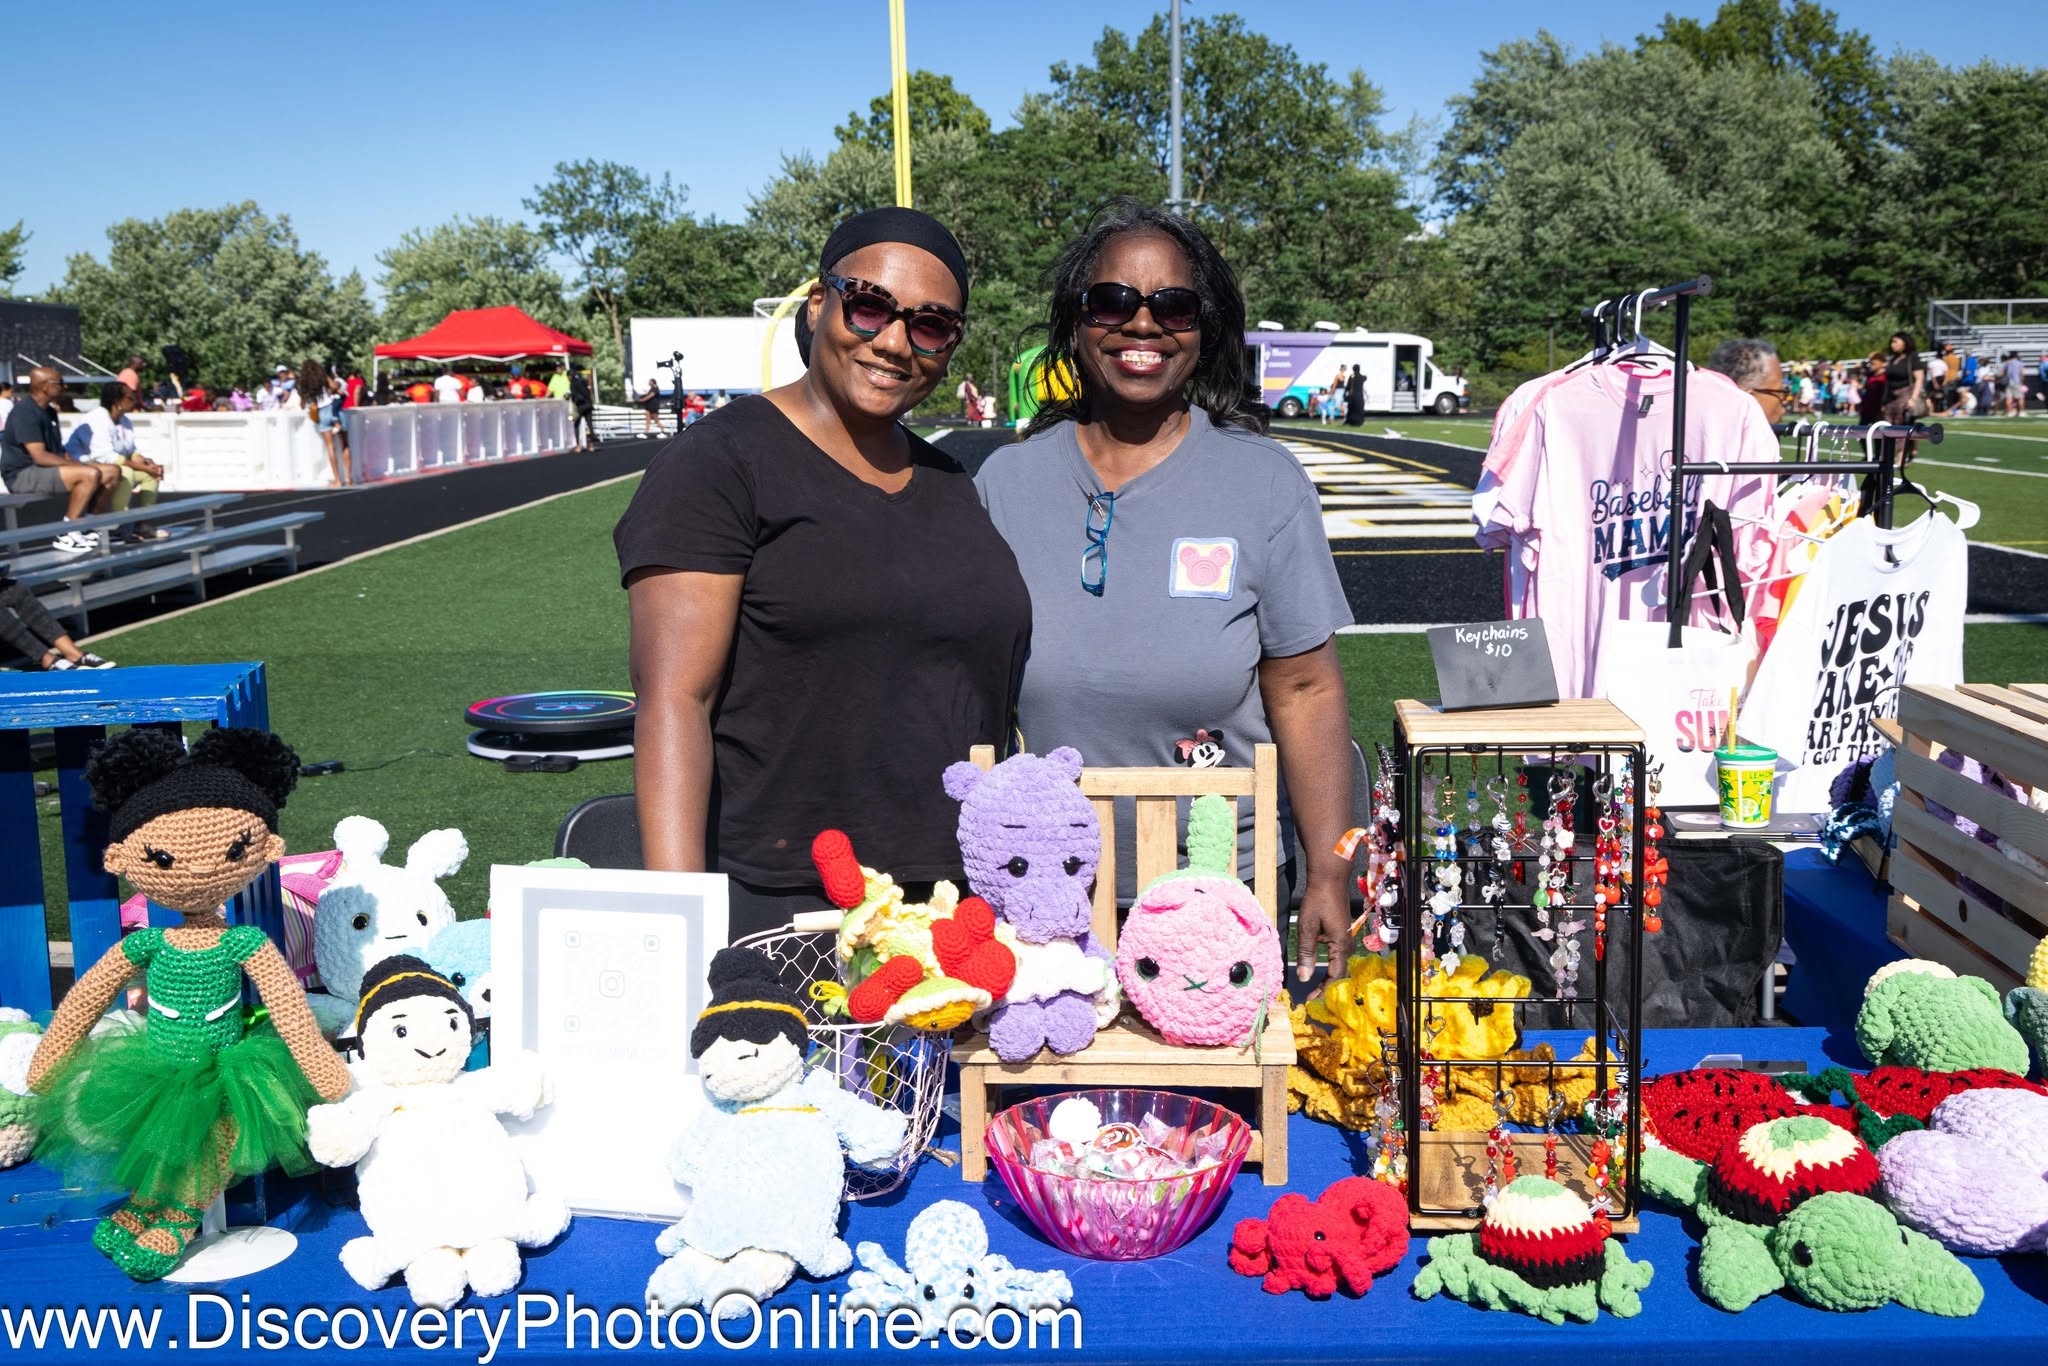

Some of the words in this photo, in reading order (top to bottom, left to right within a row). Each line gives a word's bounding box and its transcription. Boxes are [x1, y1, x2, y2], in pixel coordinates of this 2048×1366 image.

[1455, 625, 1529, 649] Keychains
[1821, 591, 1930, 668] JESUS
[1485, 642, 1512, 657] $10
[1813, 655, 1879, 718] AKE
[1813, 747, 1840, 765] GOT
